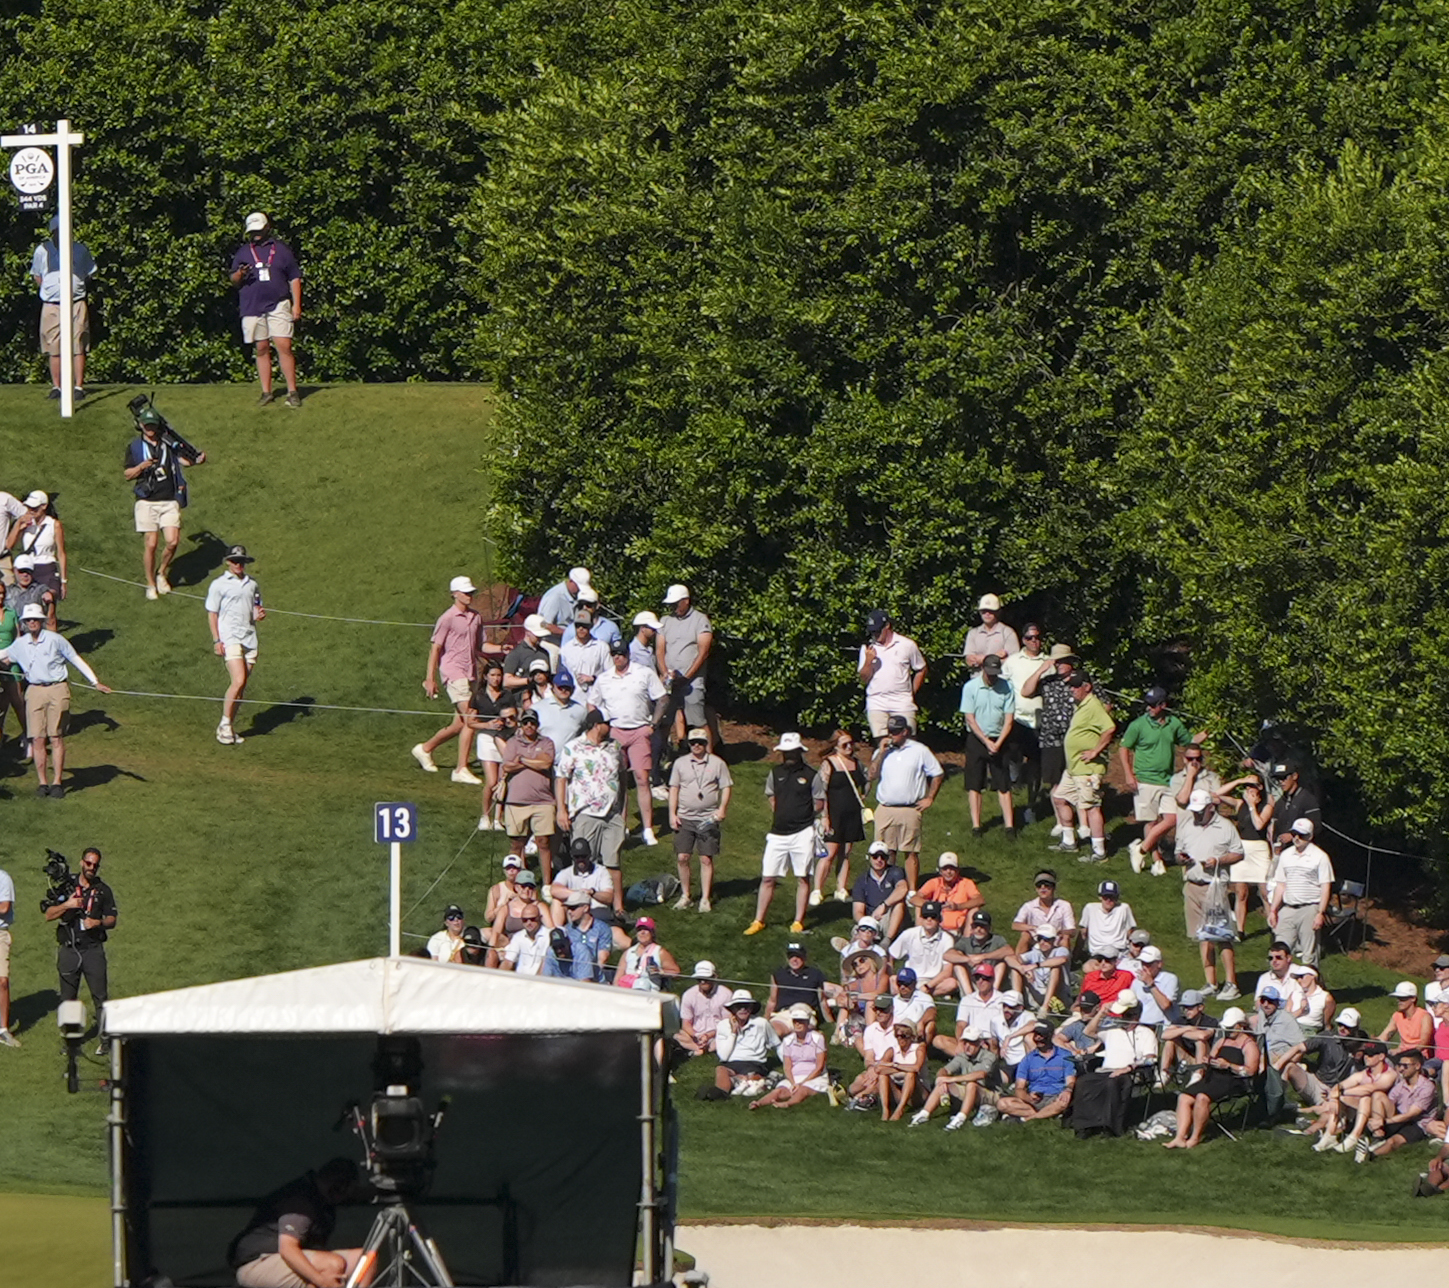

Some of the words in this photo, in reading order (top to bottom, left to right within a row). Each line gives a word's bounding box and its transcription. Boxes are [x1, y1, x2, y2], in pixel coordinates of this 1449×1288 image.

[23, 124, 36, 134] 14
[15, 163, 49, 175] PGA
[379, 807, 410, 838] 13
